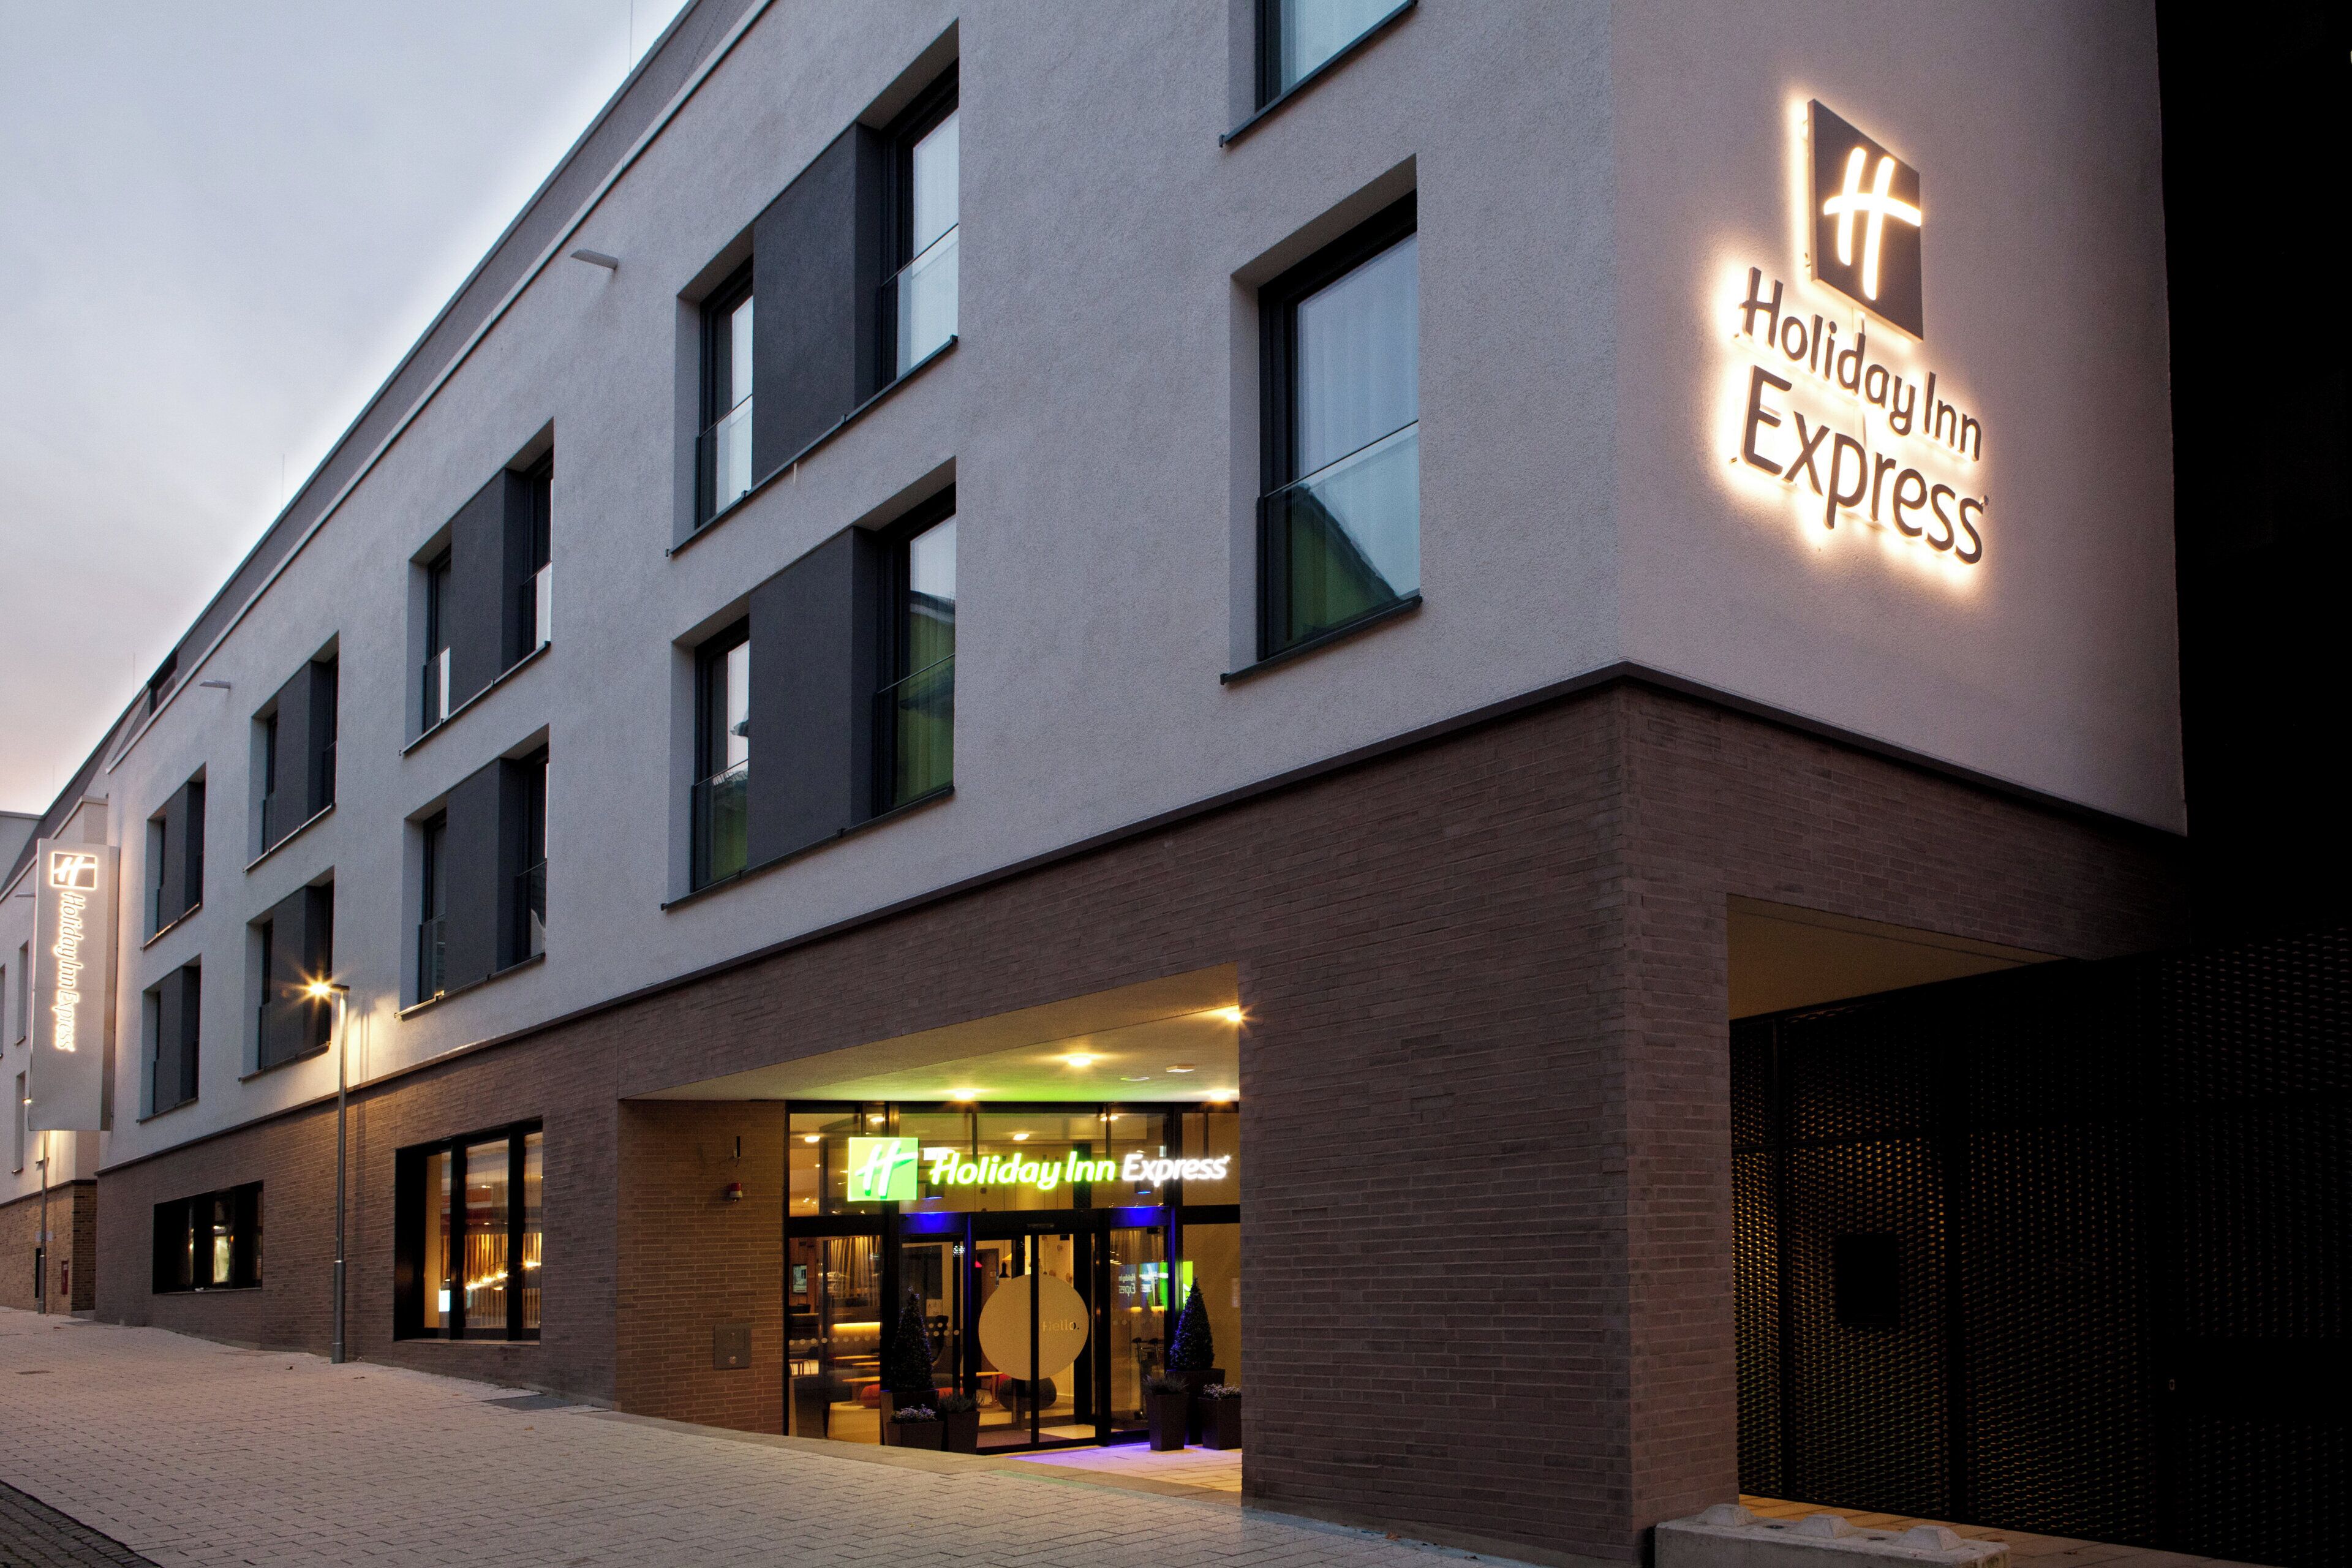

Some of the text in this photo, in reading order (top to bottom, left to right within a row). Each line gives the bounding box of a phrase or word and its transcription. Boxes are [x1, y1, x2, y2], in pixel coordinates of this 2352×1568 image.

[1738, 266, 1982, 462] Holiday Inn
[1740, 365, 1985, 565] Express
[53, 892, 85, 1049] Holiday Inn Express
[929, 1150, 1227, 1191] Holiday Inn Express
